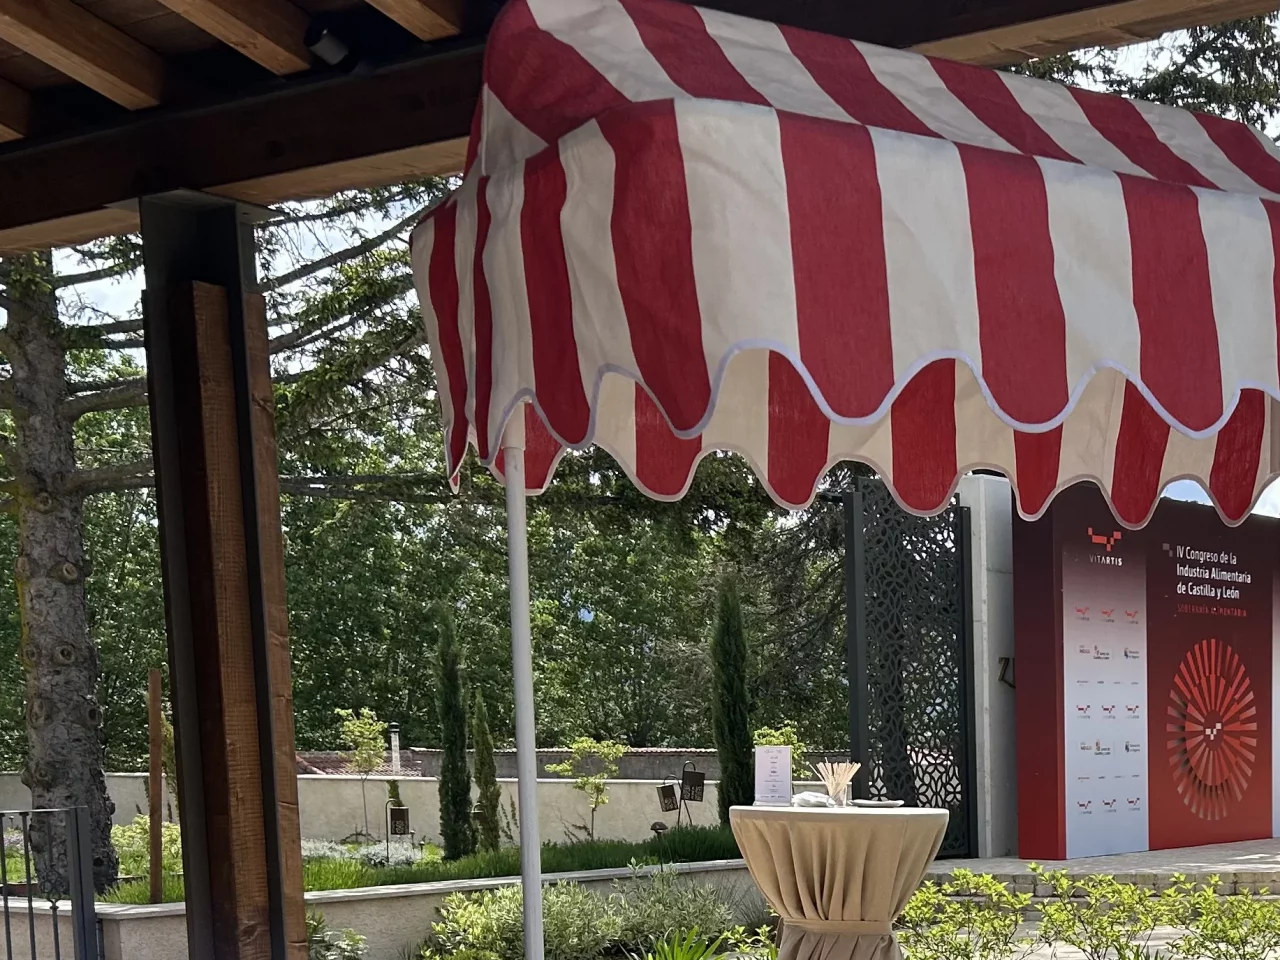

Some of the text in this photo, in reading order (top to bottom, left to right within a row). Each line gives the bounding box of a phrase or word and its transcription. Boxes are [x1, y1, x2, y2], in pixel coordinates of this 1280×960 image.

[1088, 554, 1123, 566] VITARTIS
[1176, 545, 1237, 565] IV Congreso de la
[1176, 563, 1252, 584] Industria Alimentaria
[1176, 581, 1240, 600] de Castilla y León
